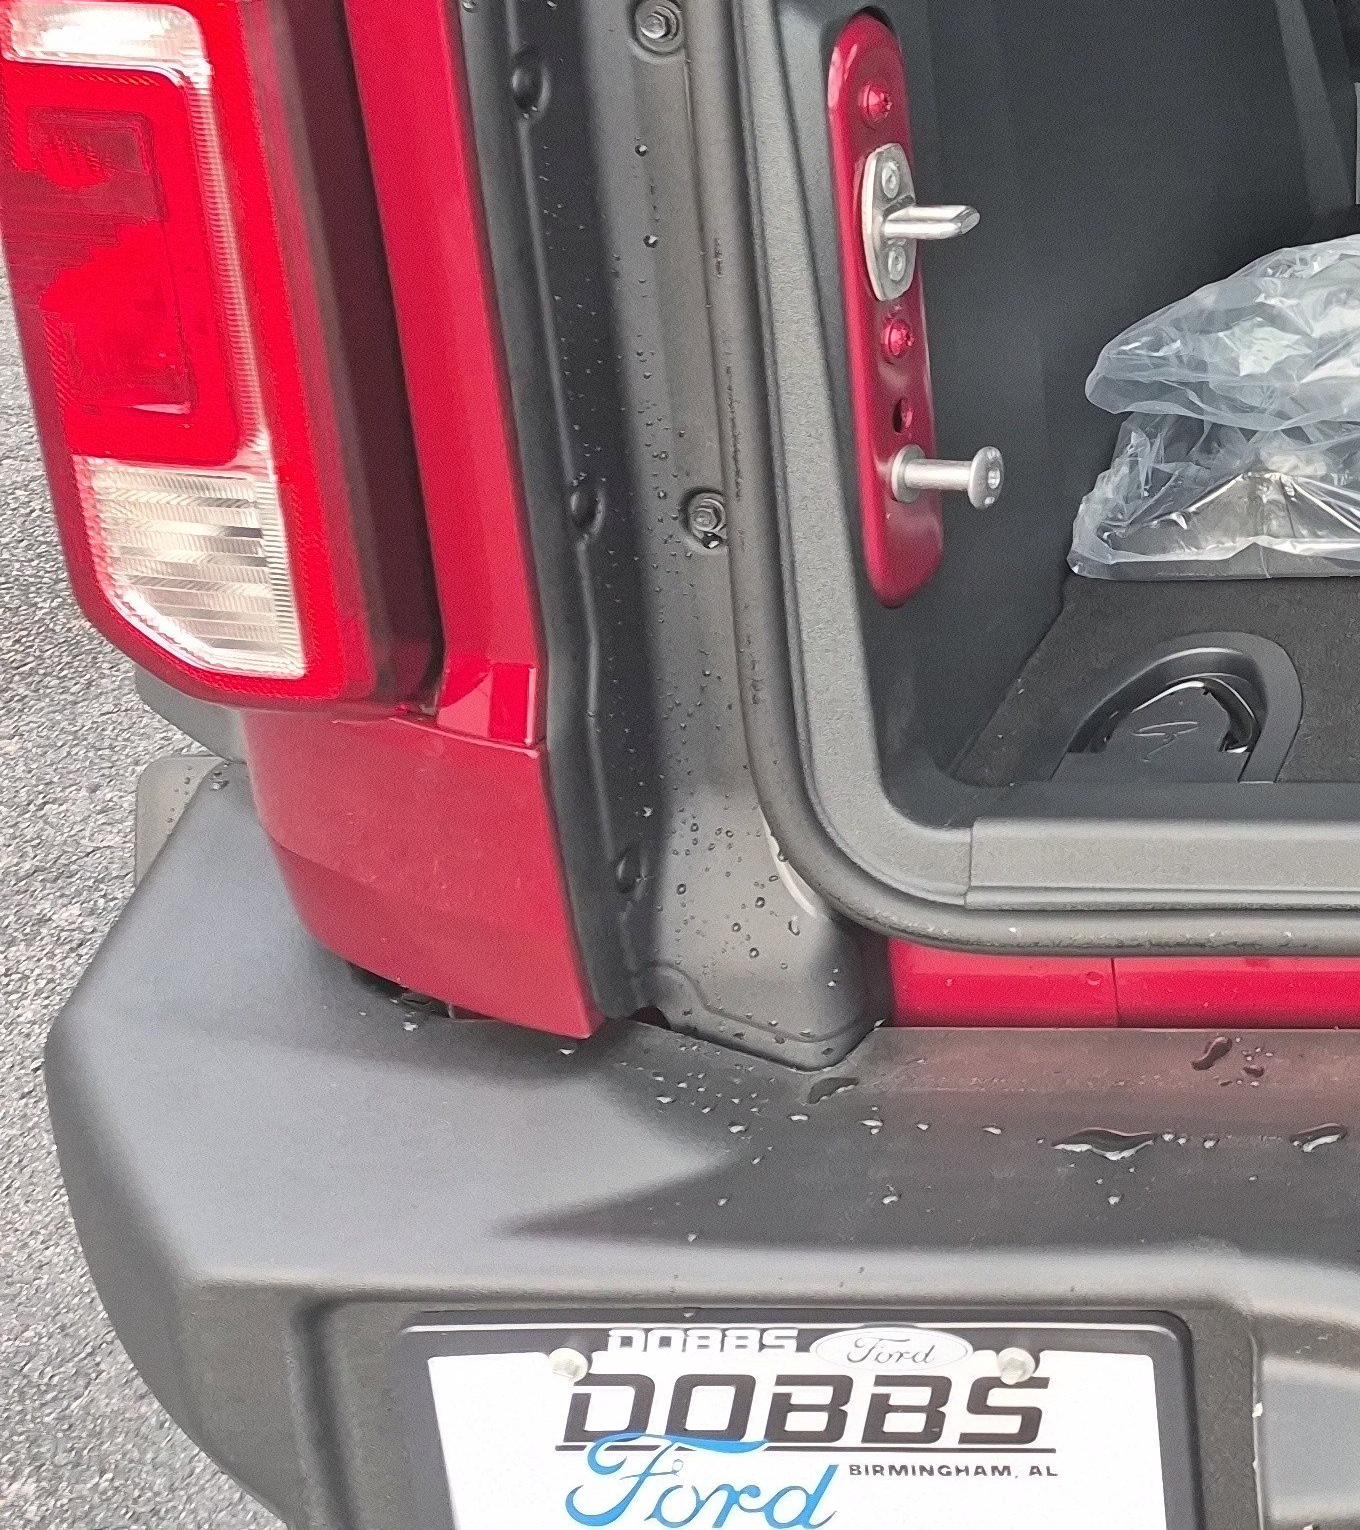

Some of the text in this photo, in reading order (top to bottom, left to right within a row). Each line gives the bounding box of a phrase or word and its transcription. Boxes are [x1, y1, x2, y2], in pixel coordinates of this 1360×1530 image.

[607, 1327, 937, 1365] DOBBS Ford
[564, 1373, 1050, 1445] DOBBS
[564, 1432, 839, 1530] Ford
[848, 1463, 1059, 1479] BIRMINGHAM, AL
